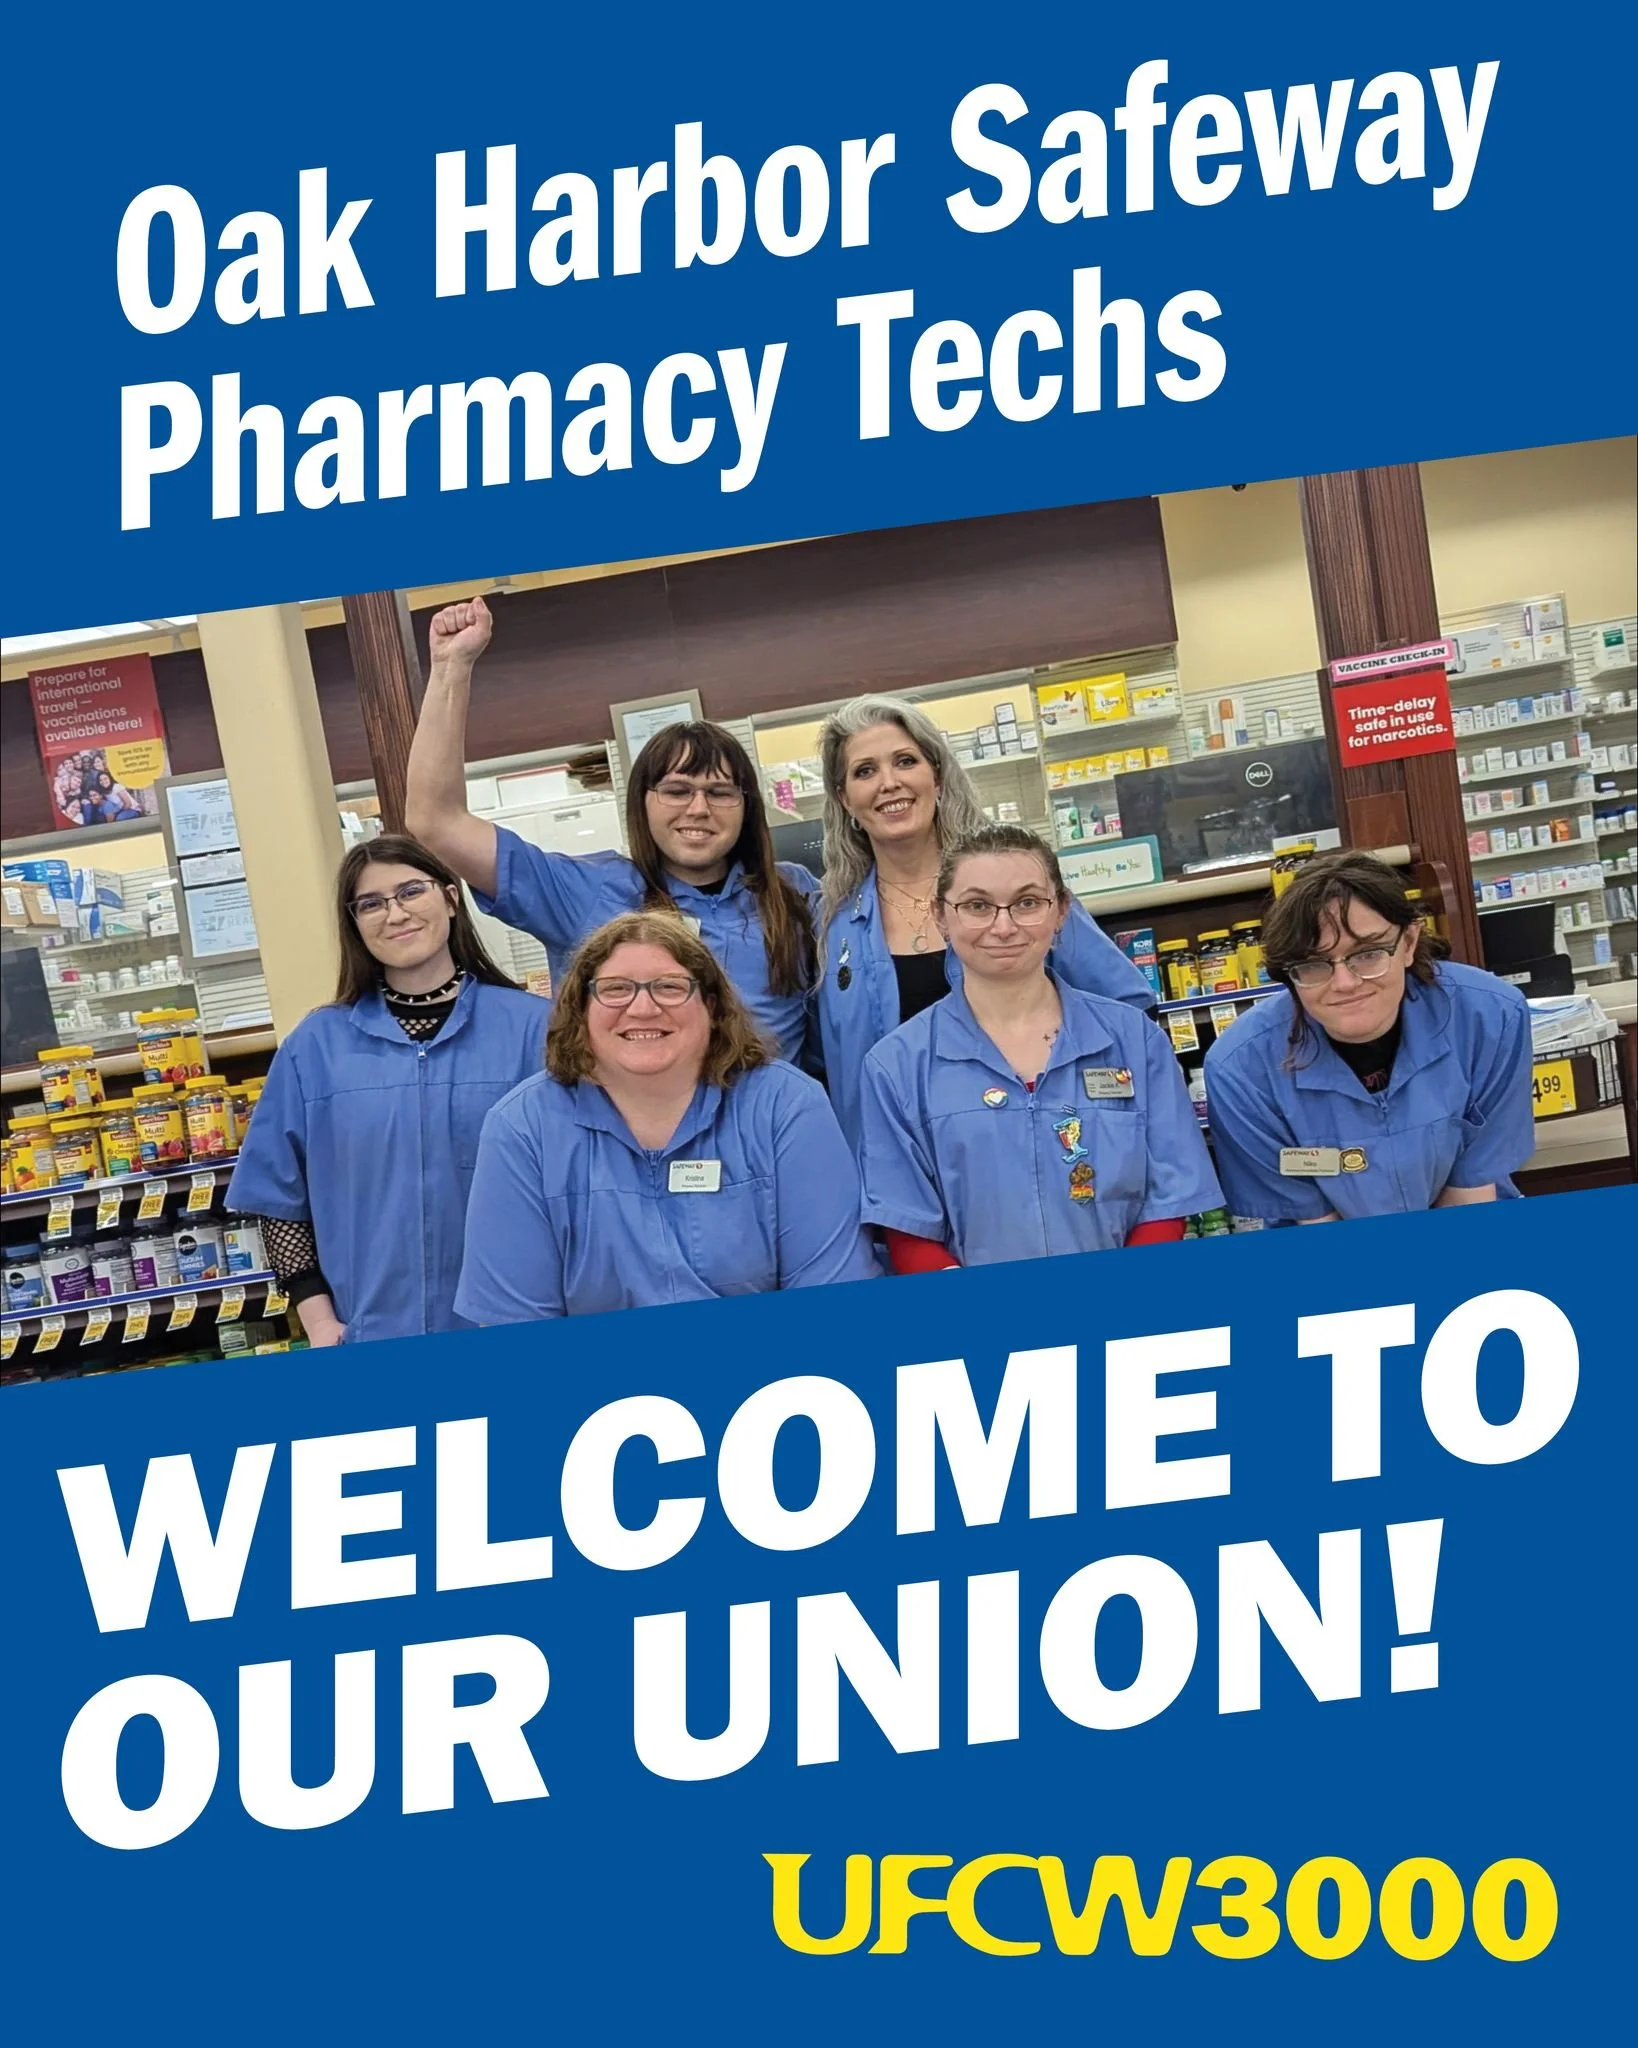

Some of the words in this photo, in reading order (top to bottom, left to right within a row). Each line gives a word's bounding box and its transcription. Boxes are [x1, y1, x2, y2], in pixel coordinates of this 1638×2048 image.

[1338, 658, 1388, 673] VACCINE
[1390, 646, 1445, 664] CHECK-IN
[35, 670, 86, 687] Prepare
[89, 666, 107, 678] for
[37, 677, 122, 700] international
[40, 698, 78, 715] travel
[42, 706, 128, 728] vaccinations
[1347, 697, 1437, 720] Time-delay
[44, 722, 107, 742] available
[108, 717, 143, 732] here!
[1355, 718, 1388, 733] safe
[1390, 715, 1406, 727] in
[1407, 711, 1435, 724] use
[1348, 735, 1370, 748] for
[1372, 723, 1448, 744] narcotics.
[1249, 770, 1270, 779] DELL
[148, 1052, 168, 1061] Multi
[144, 1126, 165, 1134] Multi
[142, 1198, 161, 1209] FREE
[191, 1191, 209, 1202] FREE
